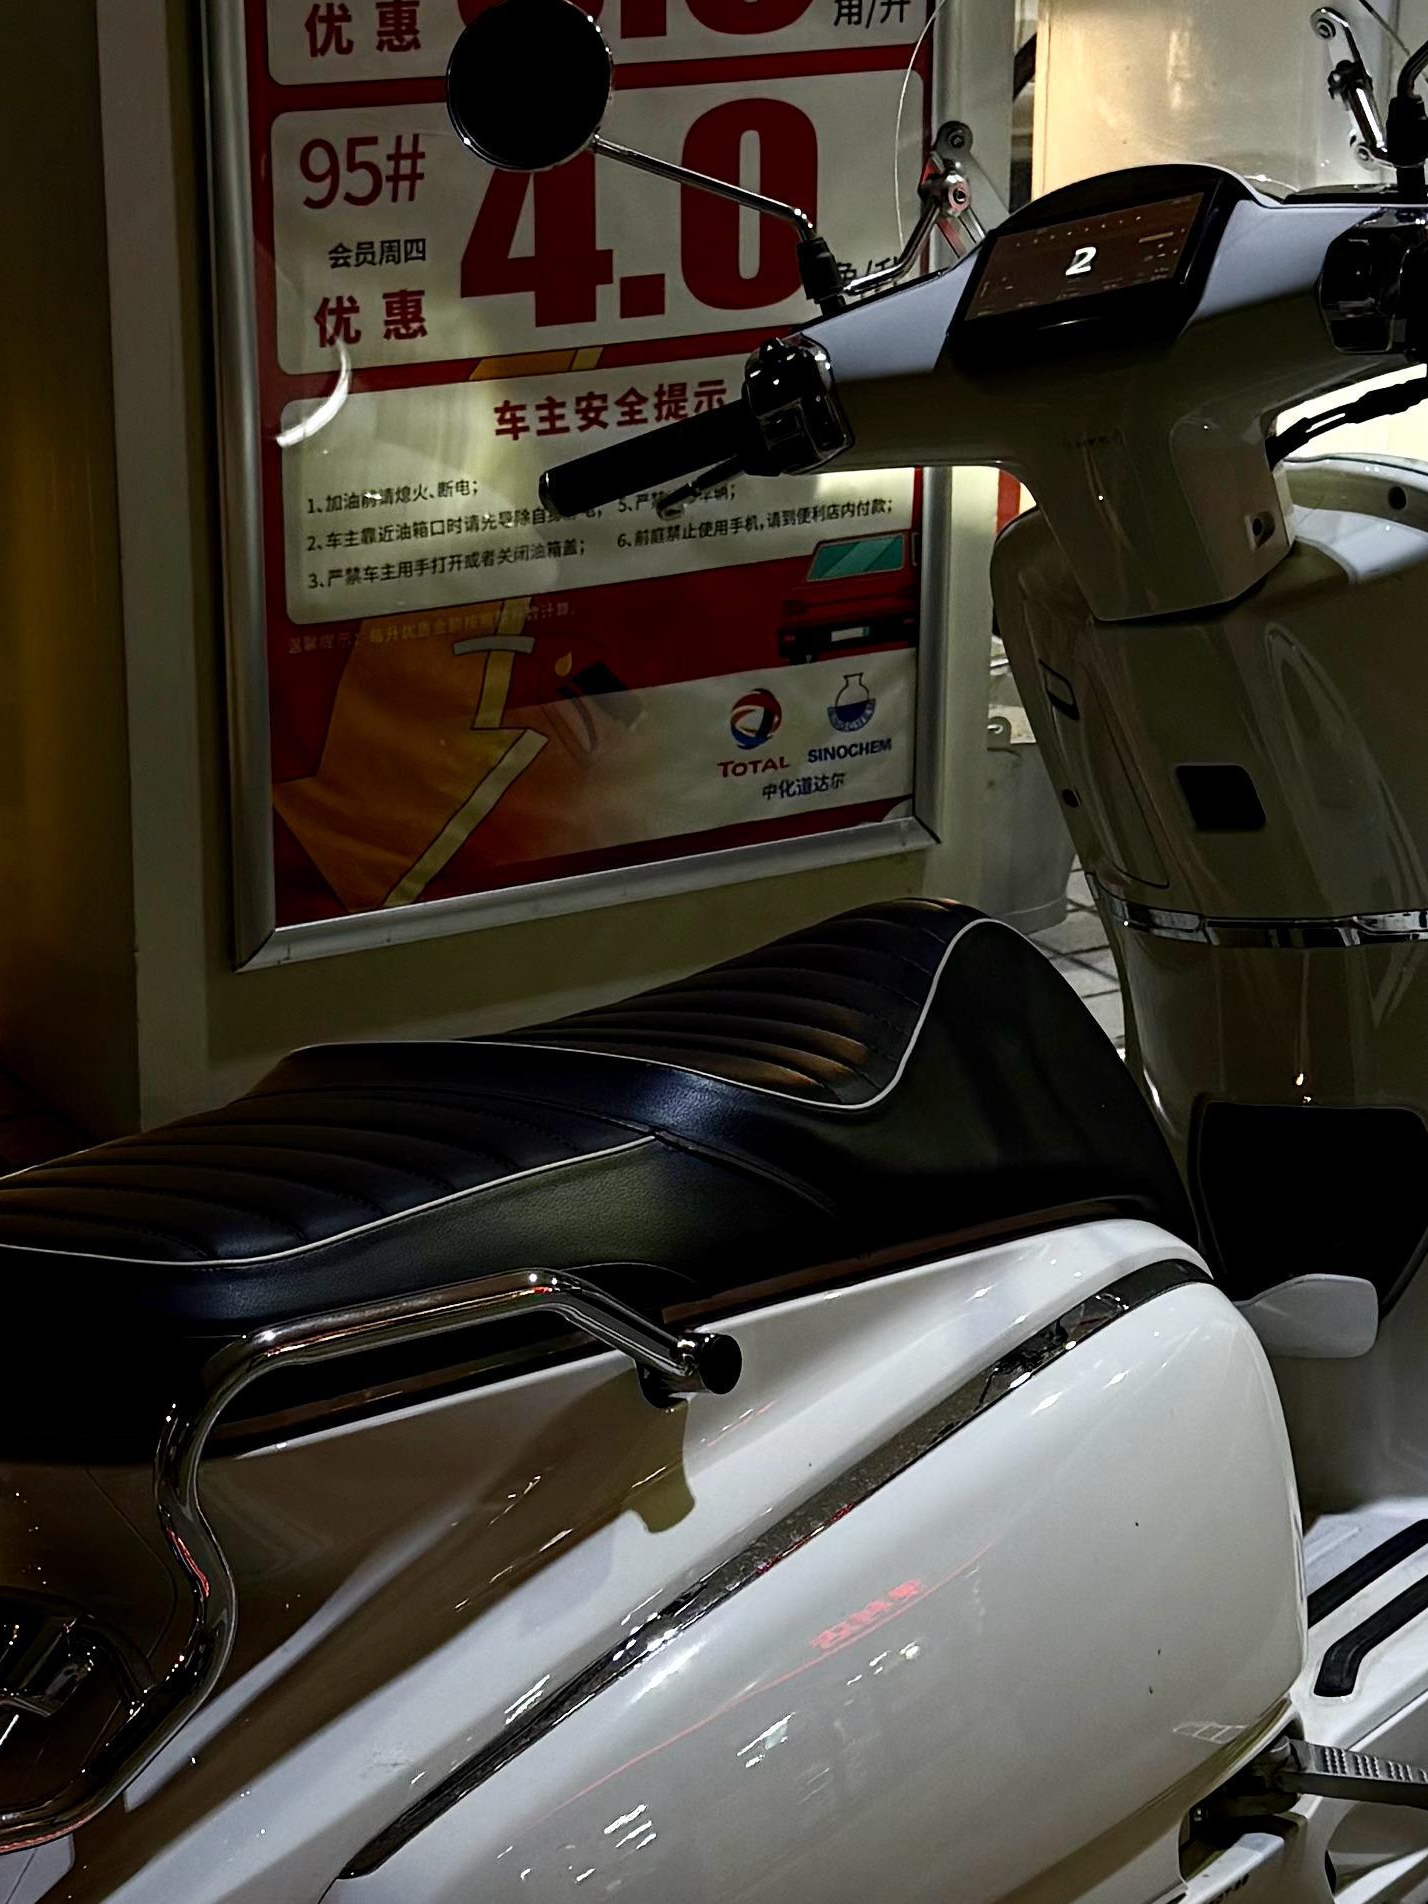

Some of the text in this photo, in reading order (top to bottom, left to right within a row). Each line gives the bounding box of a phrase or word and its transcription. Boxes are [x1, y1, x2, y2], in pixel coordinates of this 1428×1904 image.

[299, 133, 426, 210] 95#
[460, 97, 819, 329] 4.0
[327, 237, 427, 269] 会员周四
[1065, 246, 1097, 277] 2
[313, 288, 427, 349] 优惠
[494, 379, 727, 441] 车主安全提示
[717, 756, 790, 778] TOTAL
[808, 738, 892, 764] SINOCHEM
